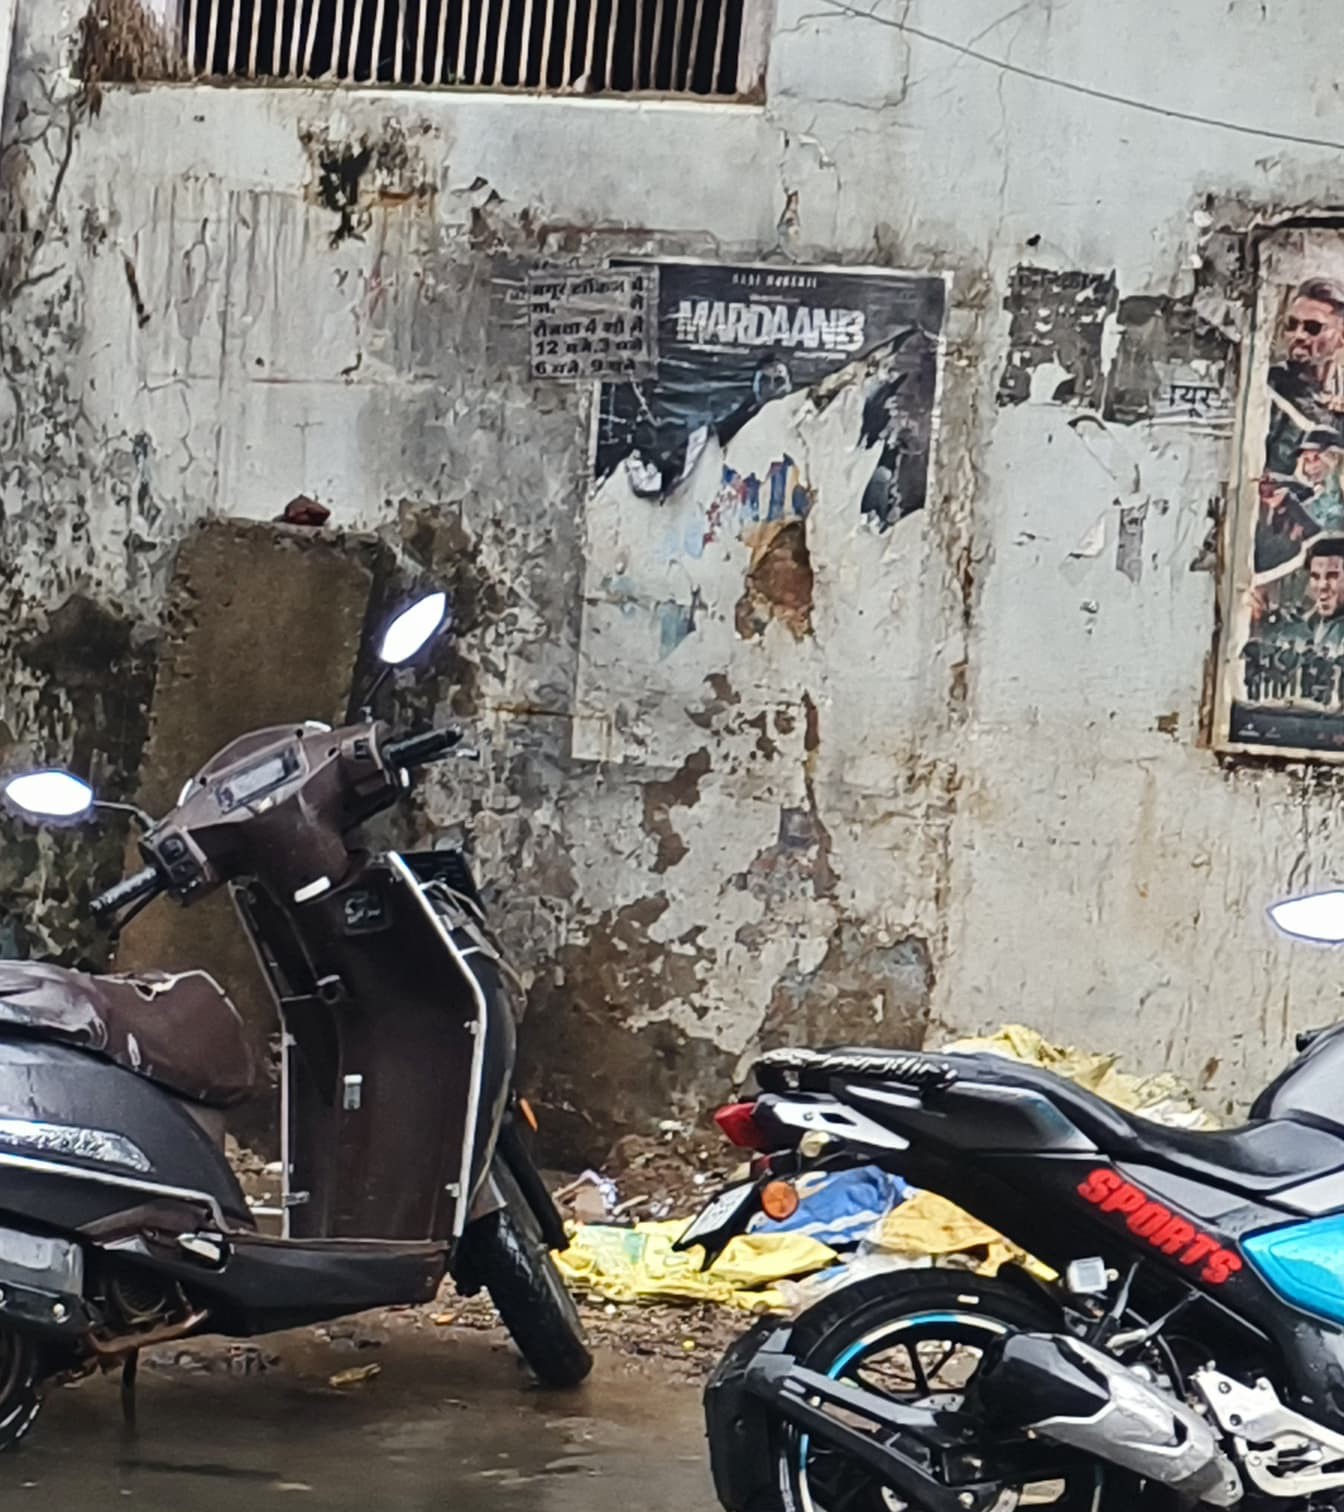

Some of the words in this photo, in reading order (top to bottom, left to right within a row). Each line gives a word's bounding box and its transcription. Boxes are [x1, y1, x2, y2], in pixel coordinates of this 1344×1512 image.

[535, 339, 559, 355] 12
[534, 360, 547, 375] 6
[1076, 1167, 1243, 1286] SPORTS
